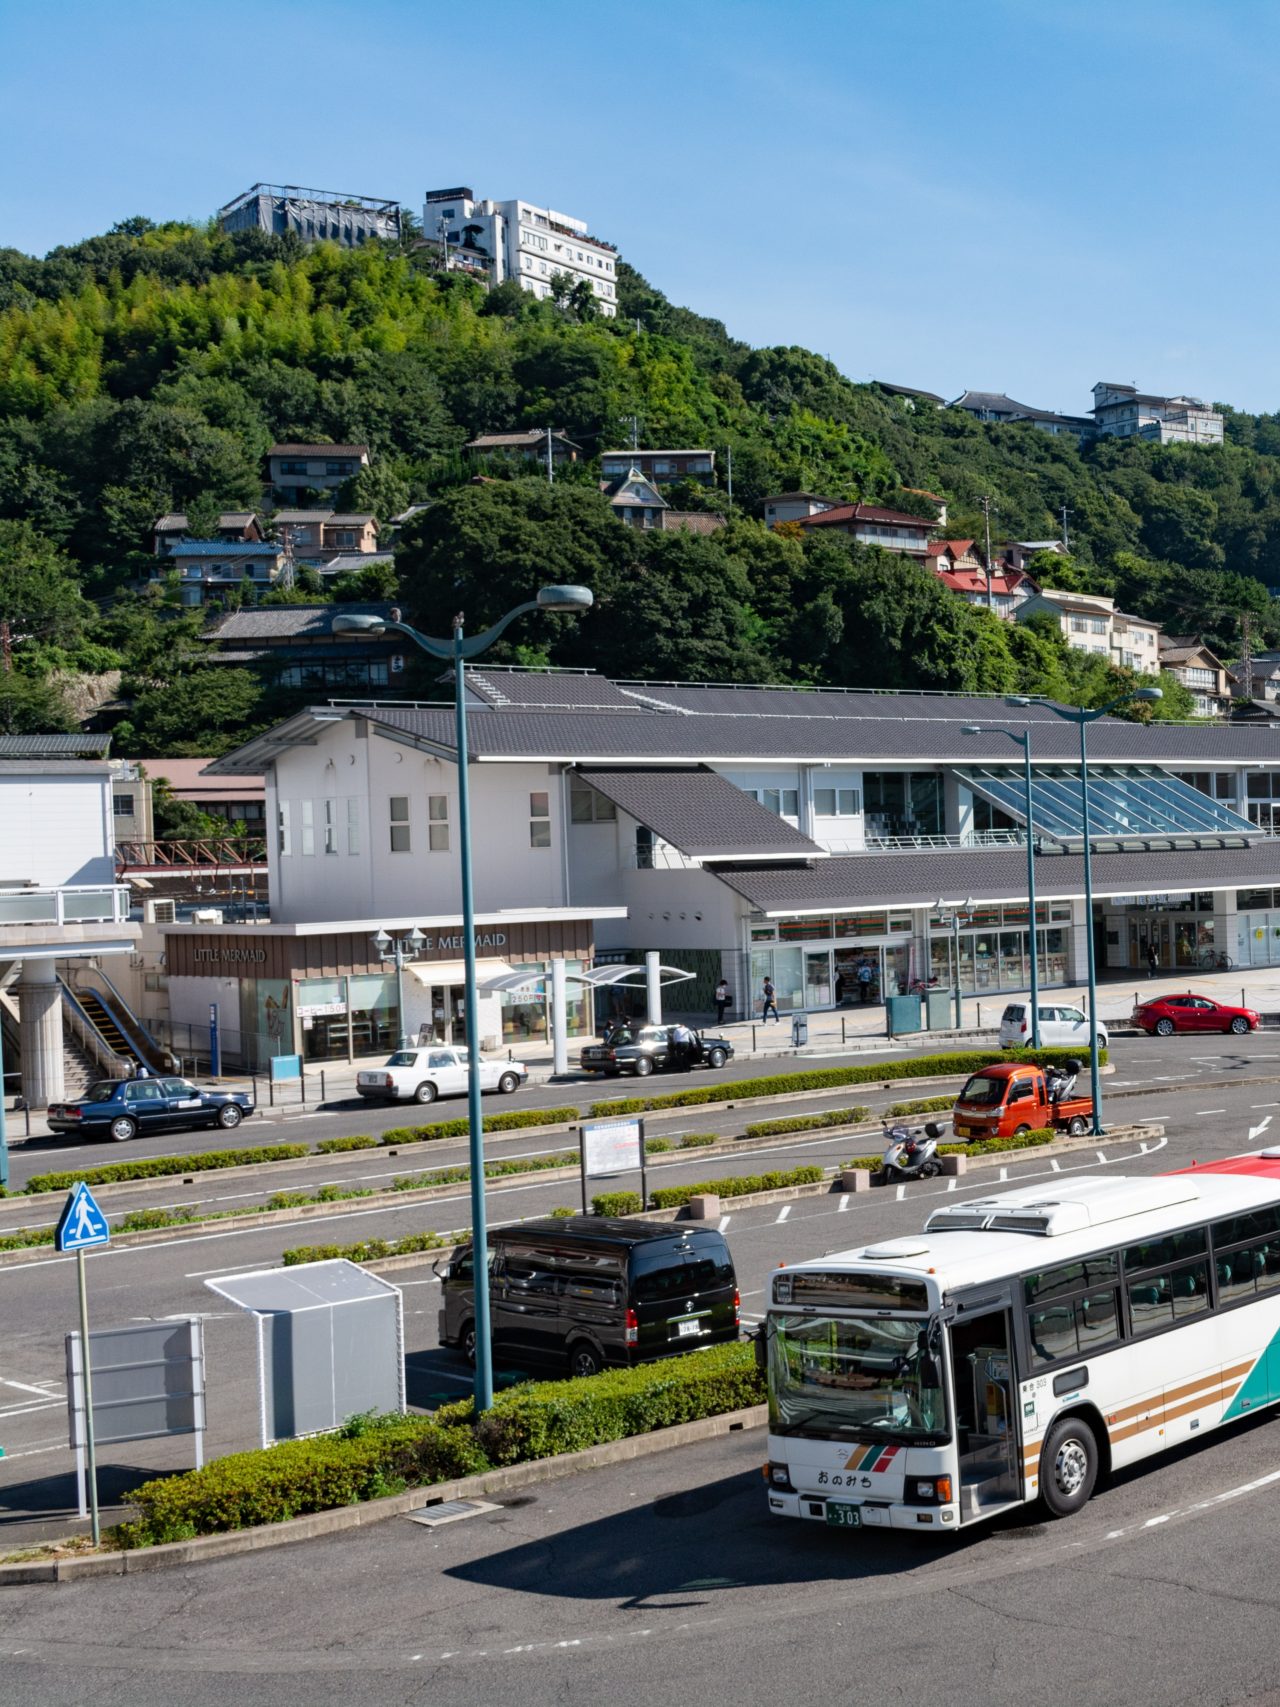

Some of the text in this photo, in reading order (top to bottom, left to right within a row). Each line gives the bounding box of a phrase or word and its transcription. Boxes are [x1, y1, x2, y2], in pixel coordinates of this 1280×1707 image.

[194, 948, 267, 963] LITTLE MERMAID
[817, 1470, 872, 1489] おのみち
[838, 1510, 859, 1525] 303
